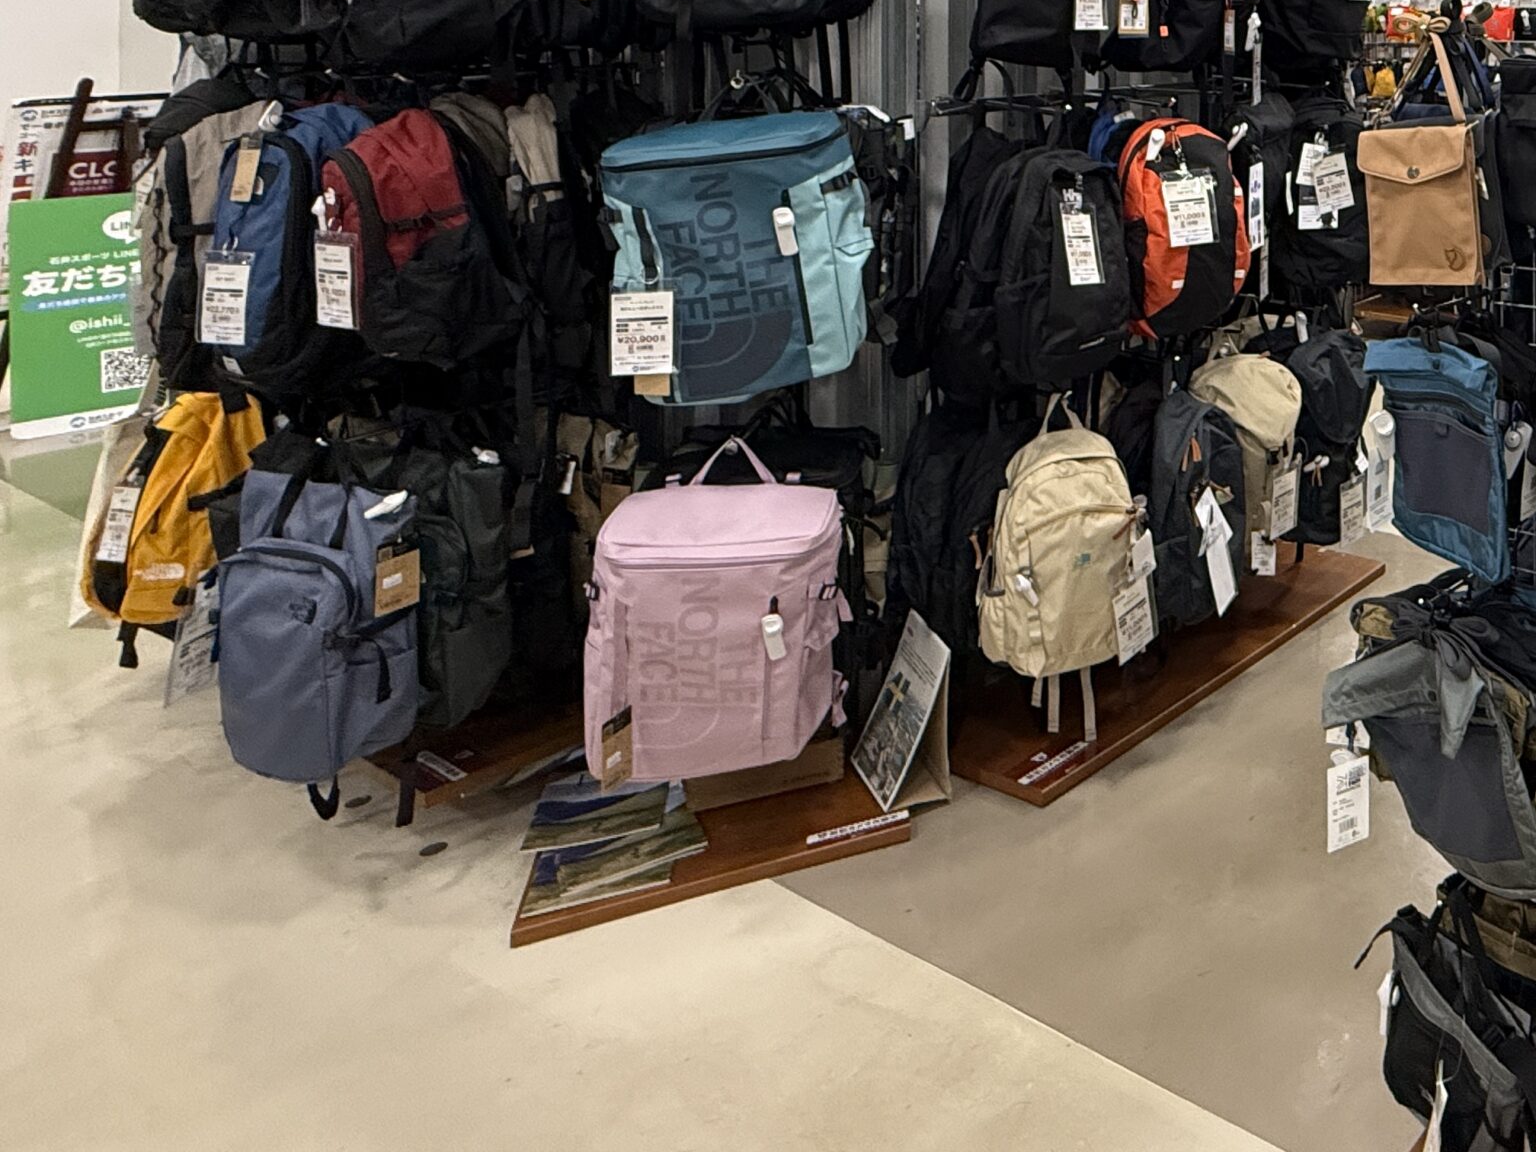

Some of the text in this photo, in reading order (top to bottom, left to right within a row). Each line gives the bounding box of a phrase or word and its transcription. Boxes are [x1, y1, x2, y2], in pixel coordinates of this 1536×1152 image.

[111, 219, 132, 231] LIN
[657, 220, 710, 321] FACE
[690, 172, 751, 318] NORTH
[69, 314, 131, 334] @ishii_
[637, 620, 678, 702] FACE
[678, 577, 720, 704] NORTH
